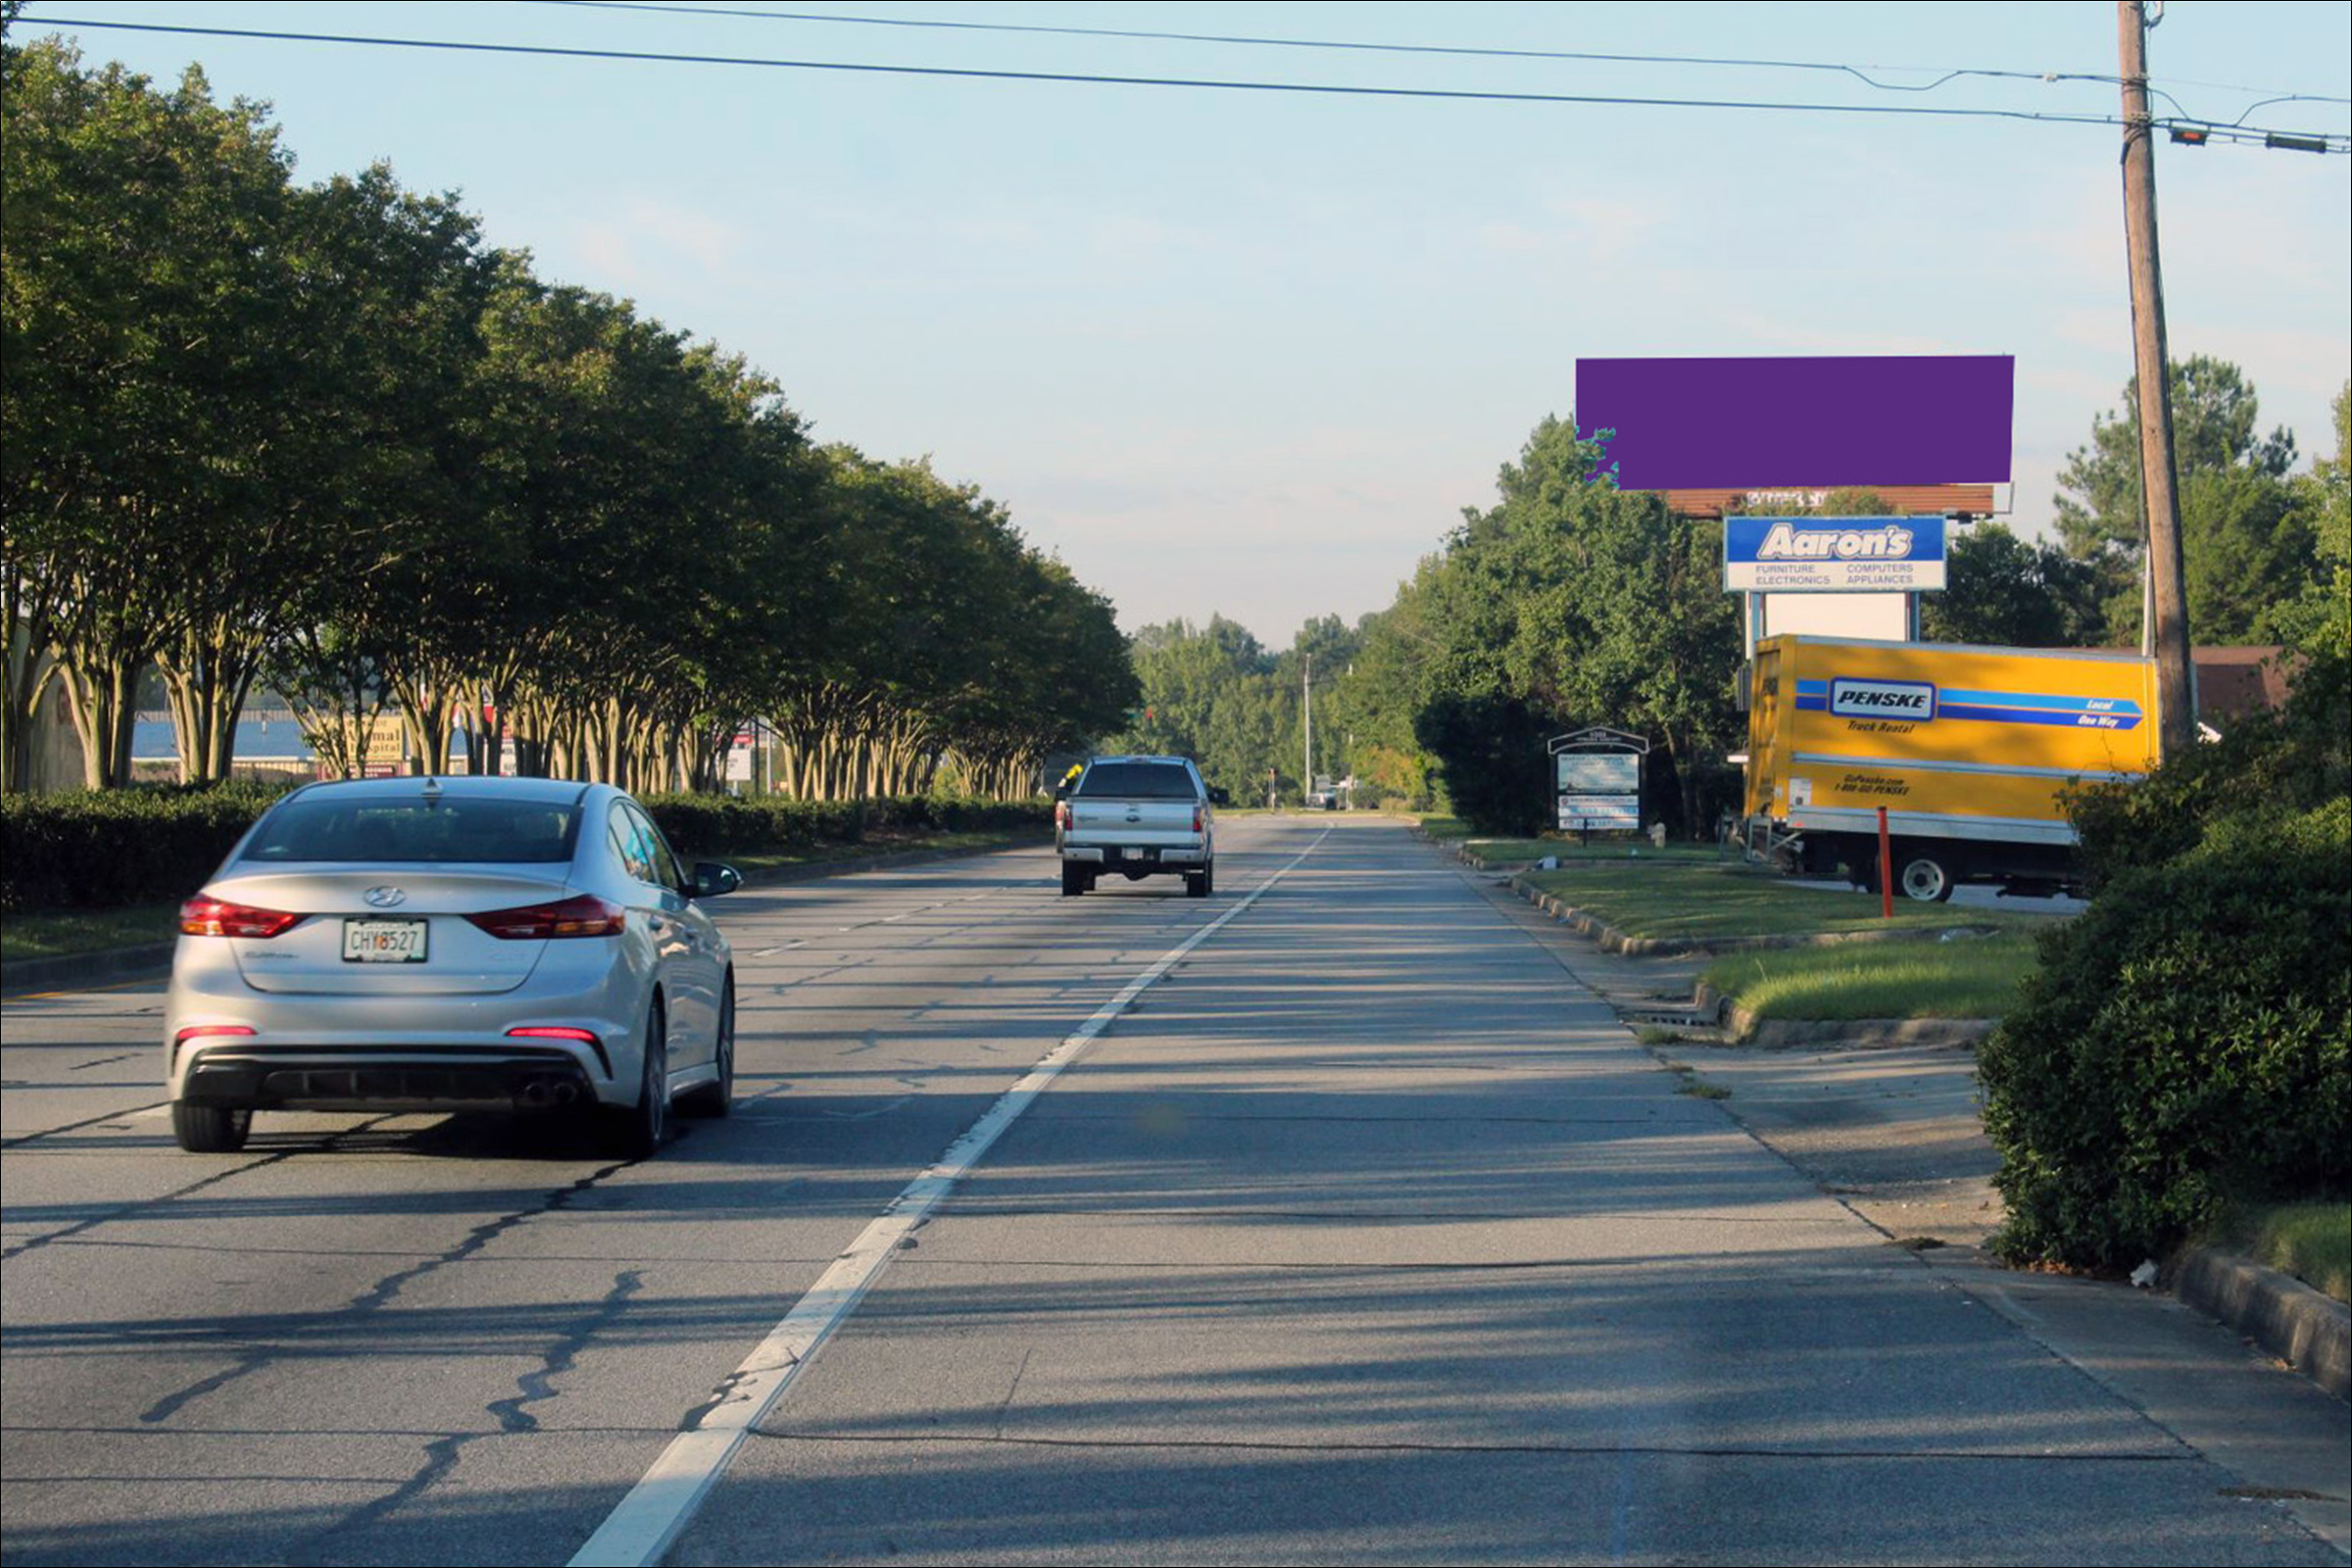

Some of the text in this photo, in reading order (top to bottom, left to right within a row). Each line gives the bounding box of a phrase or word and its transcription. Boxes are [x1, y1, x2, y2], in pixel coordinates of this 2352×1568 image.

[1758, 522, 1912, 559] Aaron's
[1755, 564, 1816, 574] FURNITURE
[1846, 564, 1914, 574] COMPUTERS
[1755, 575, 1831, 586] ELECTRONICS
[1846, 575, 1914, 585] APPLIANCES
[1838, 690, 1928, 710] PENSKE
[2085, 699, 2115, 710] Local
[1847, 719, 1916, 734] Truck Rental
[2077, 714, 2120, 729] One Way
